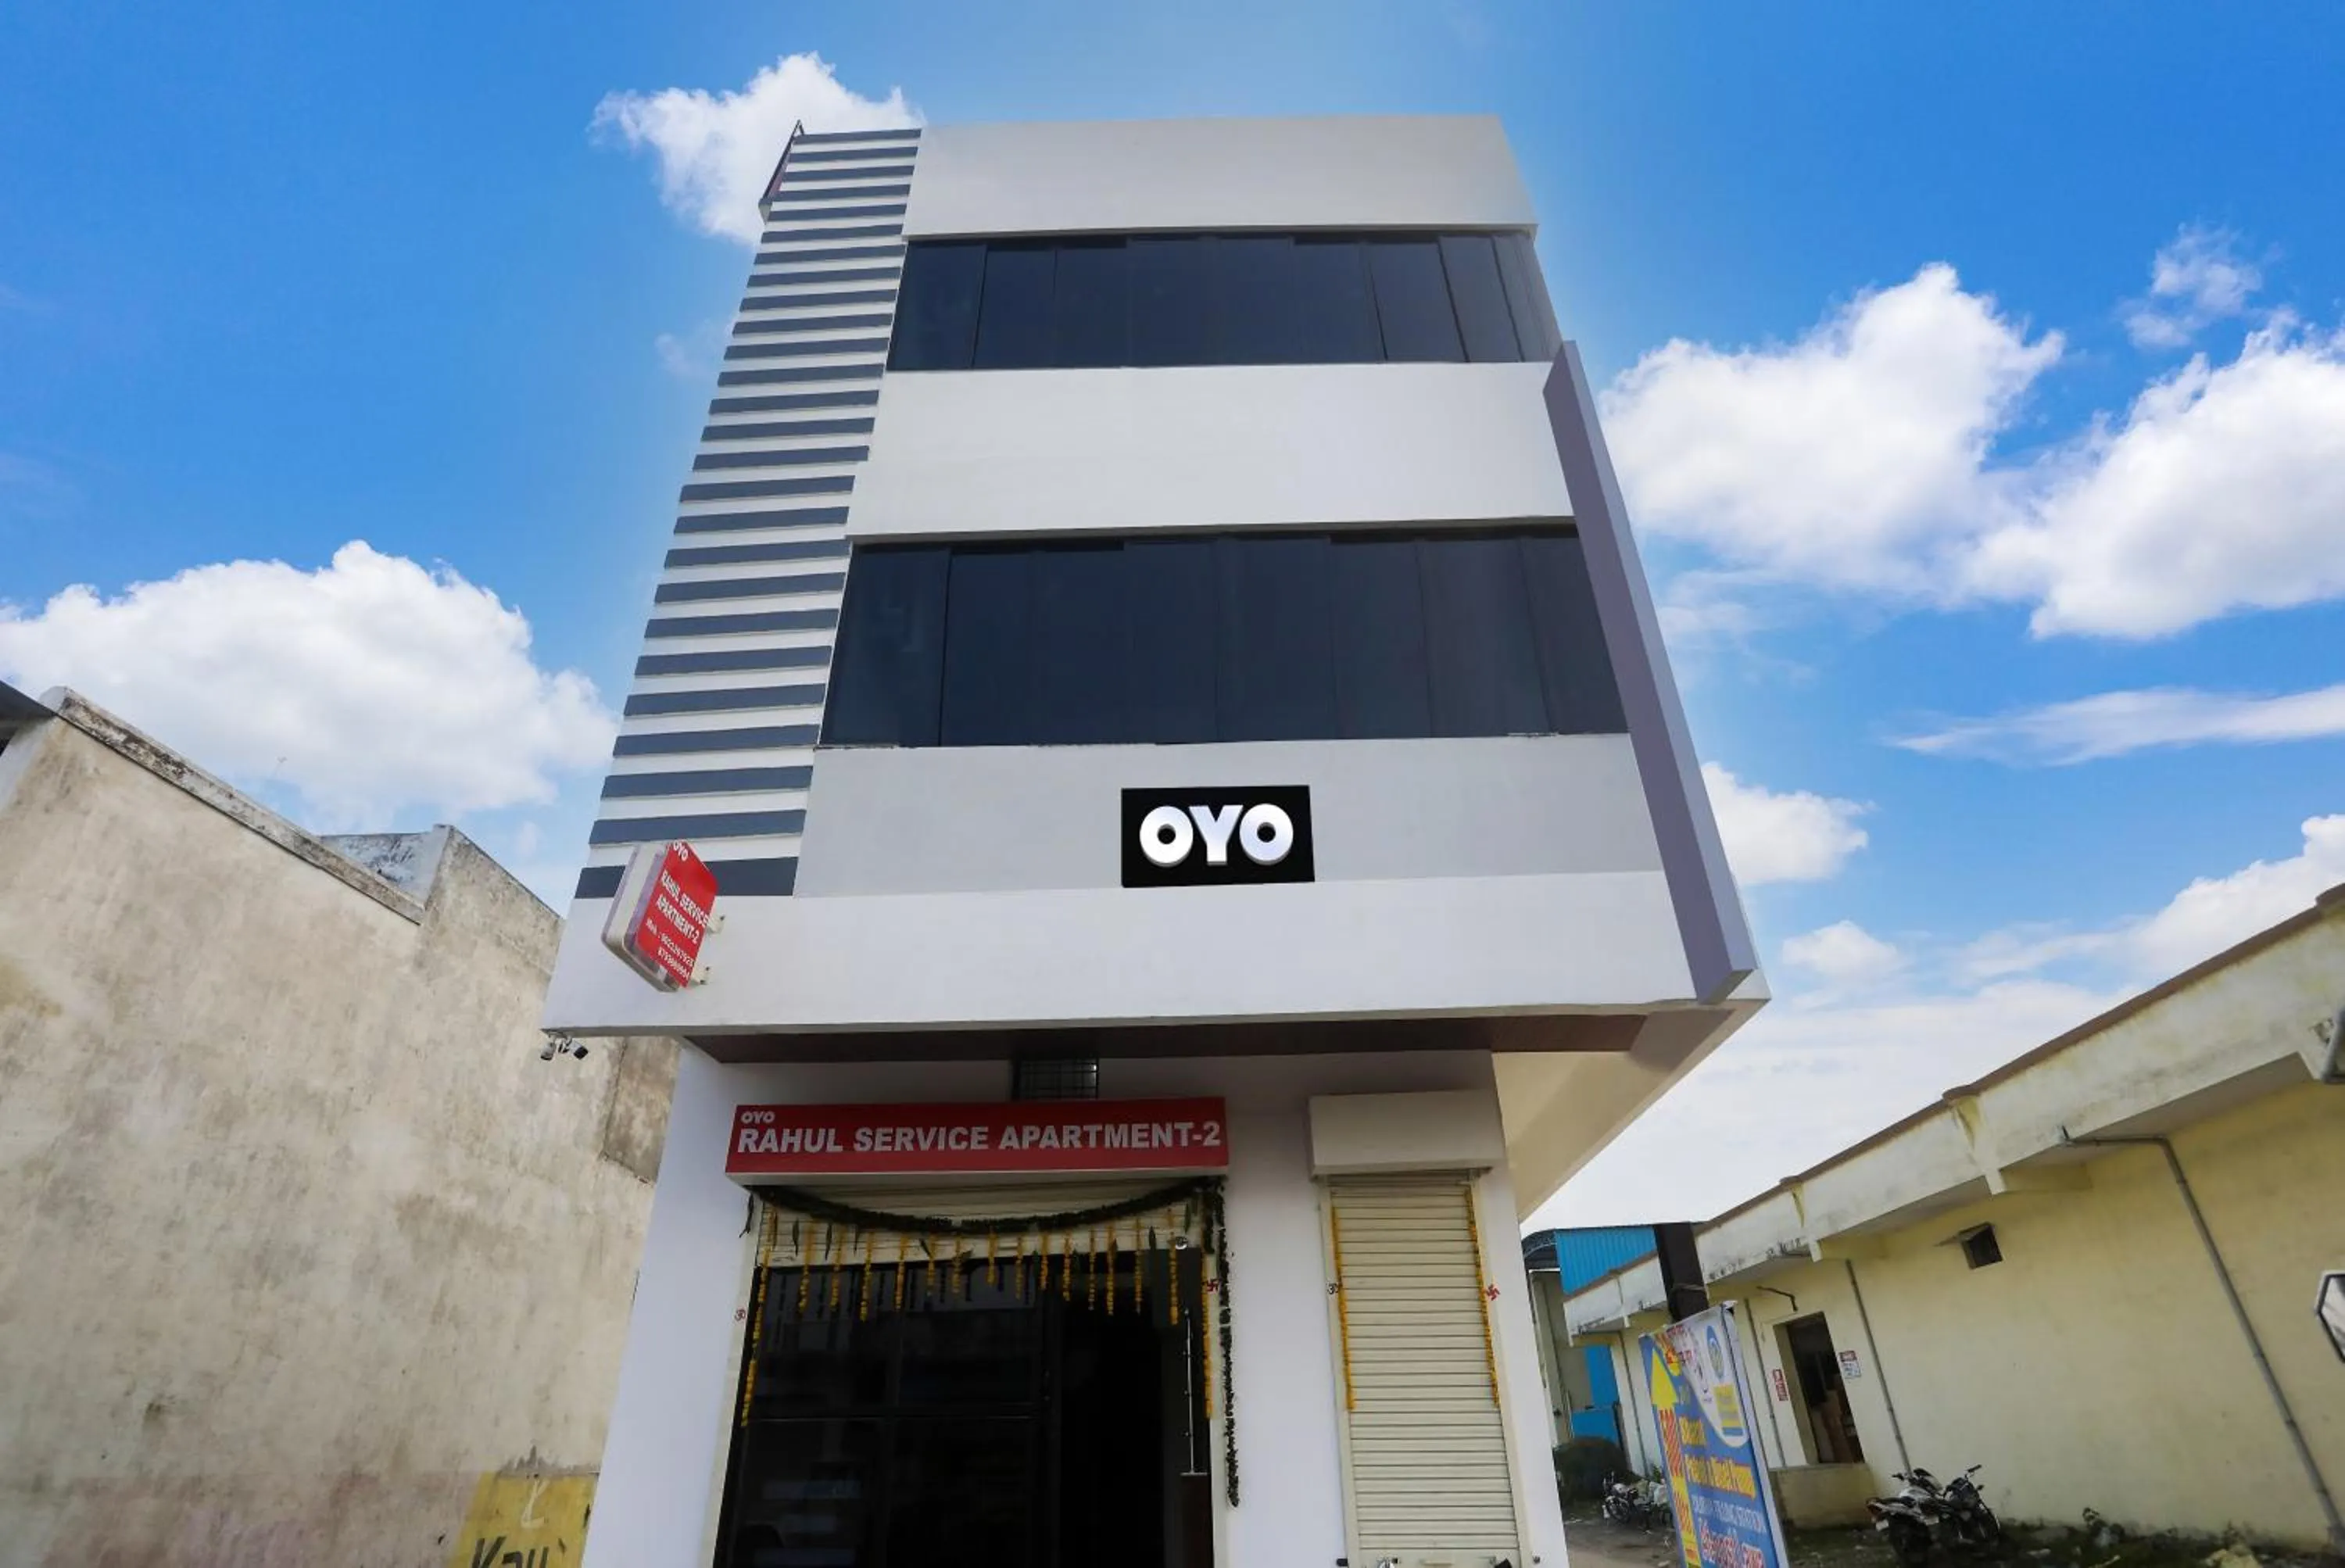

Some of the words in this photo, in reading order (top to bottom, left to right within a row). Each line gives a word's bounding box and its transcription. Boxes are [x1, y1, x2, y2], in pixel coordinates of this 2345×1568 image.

[1139, 803, 1294, 868] OYO
[673, 840, 689, 861] OYO
[740, 1111, 775, 1124] OYO
[737, 1128, 843, 1153] RAHUL
[853, 1126, 989, 1151] SERVICE
[998, 1121, 1222, 1149] APARTMENT-2
